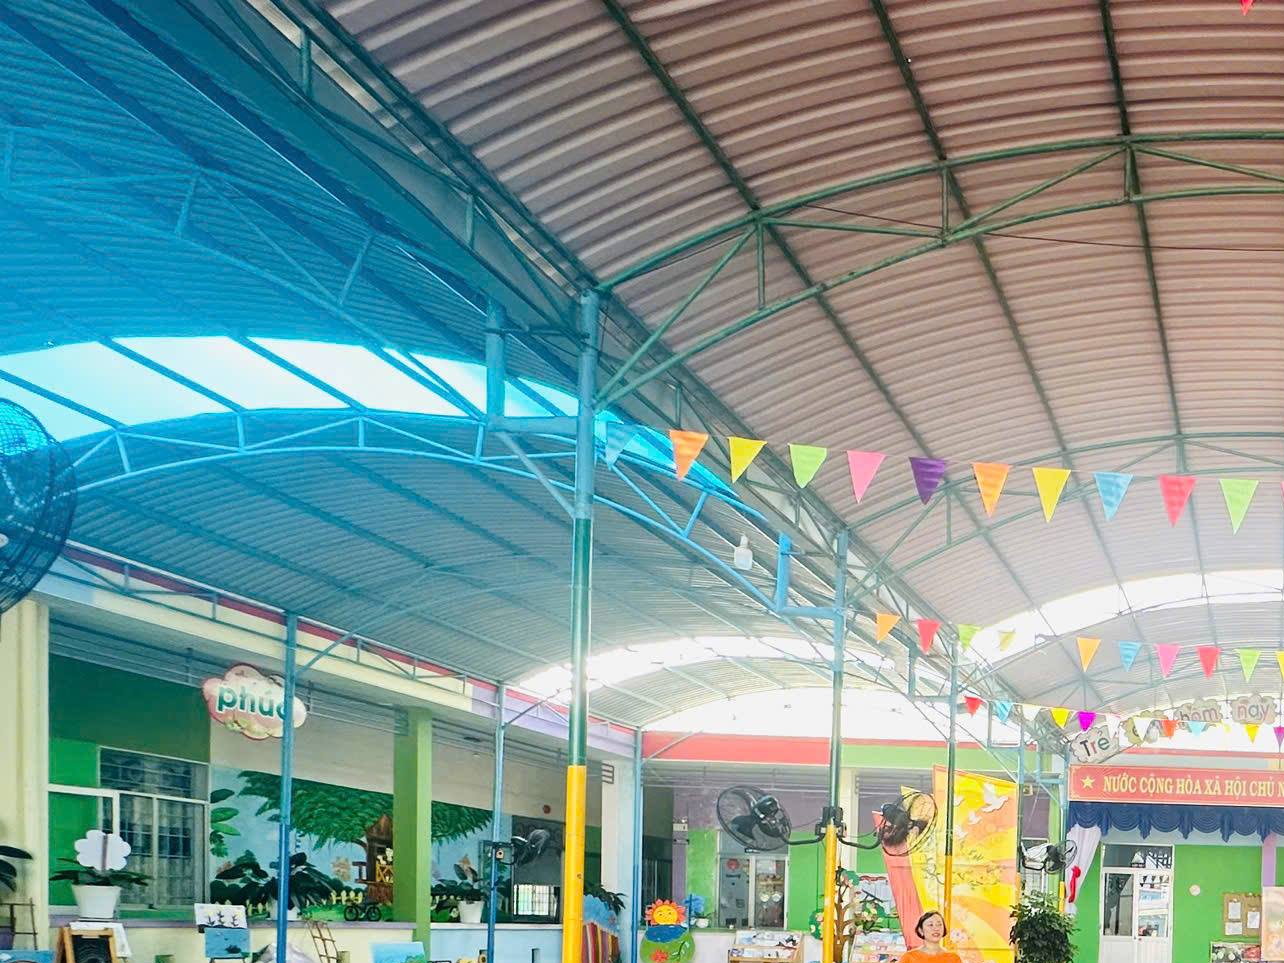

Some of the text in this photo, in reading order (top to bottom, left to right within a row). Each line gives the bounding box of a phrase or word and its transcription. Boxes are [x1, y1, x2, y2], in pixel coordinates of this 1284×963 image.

[1237, 703, 1270, 722] nay
[1139, 773, 1173, 797] CỘNG
[1224, 775, 1247, 800] HỘI
